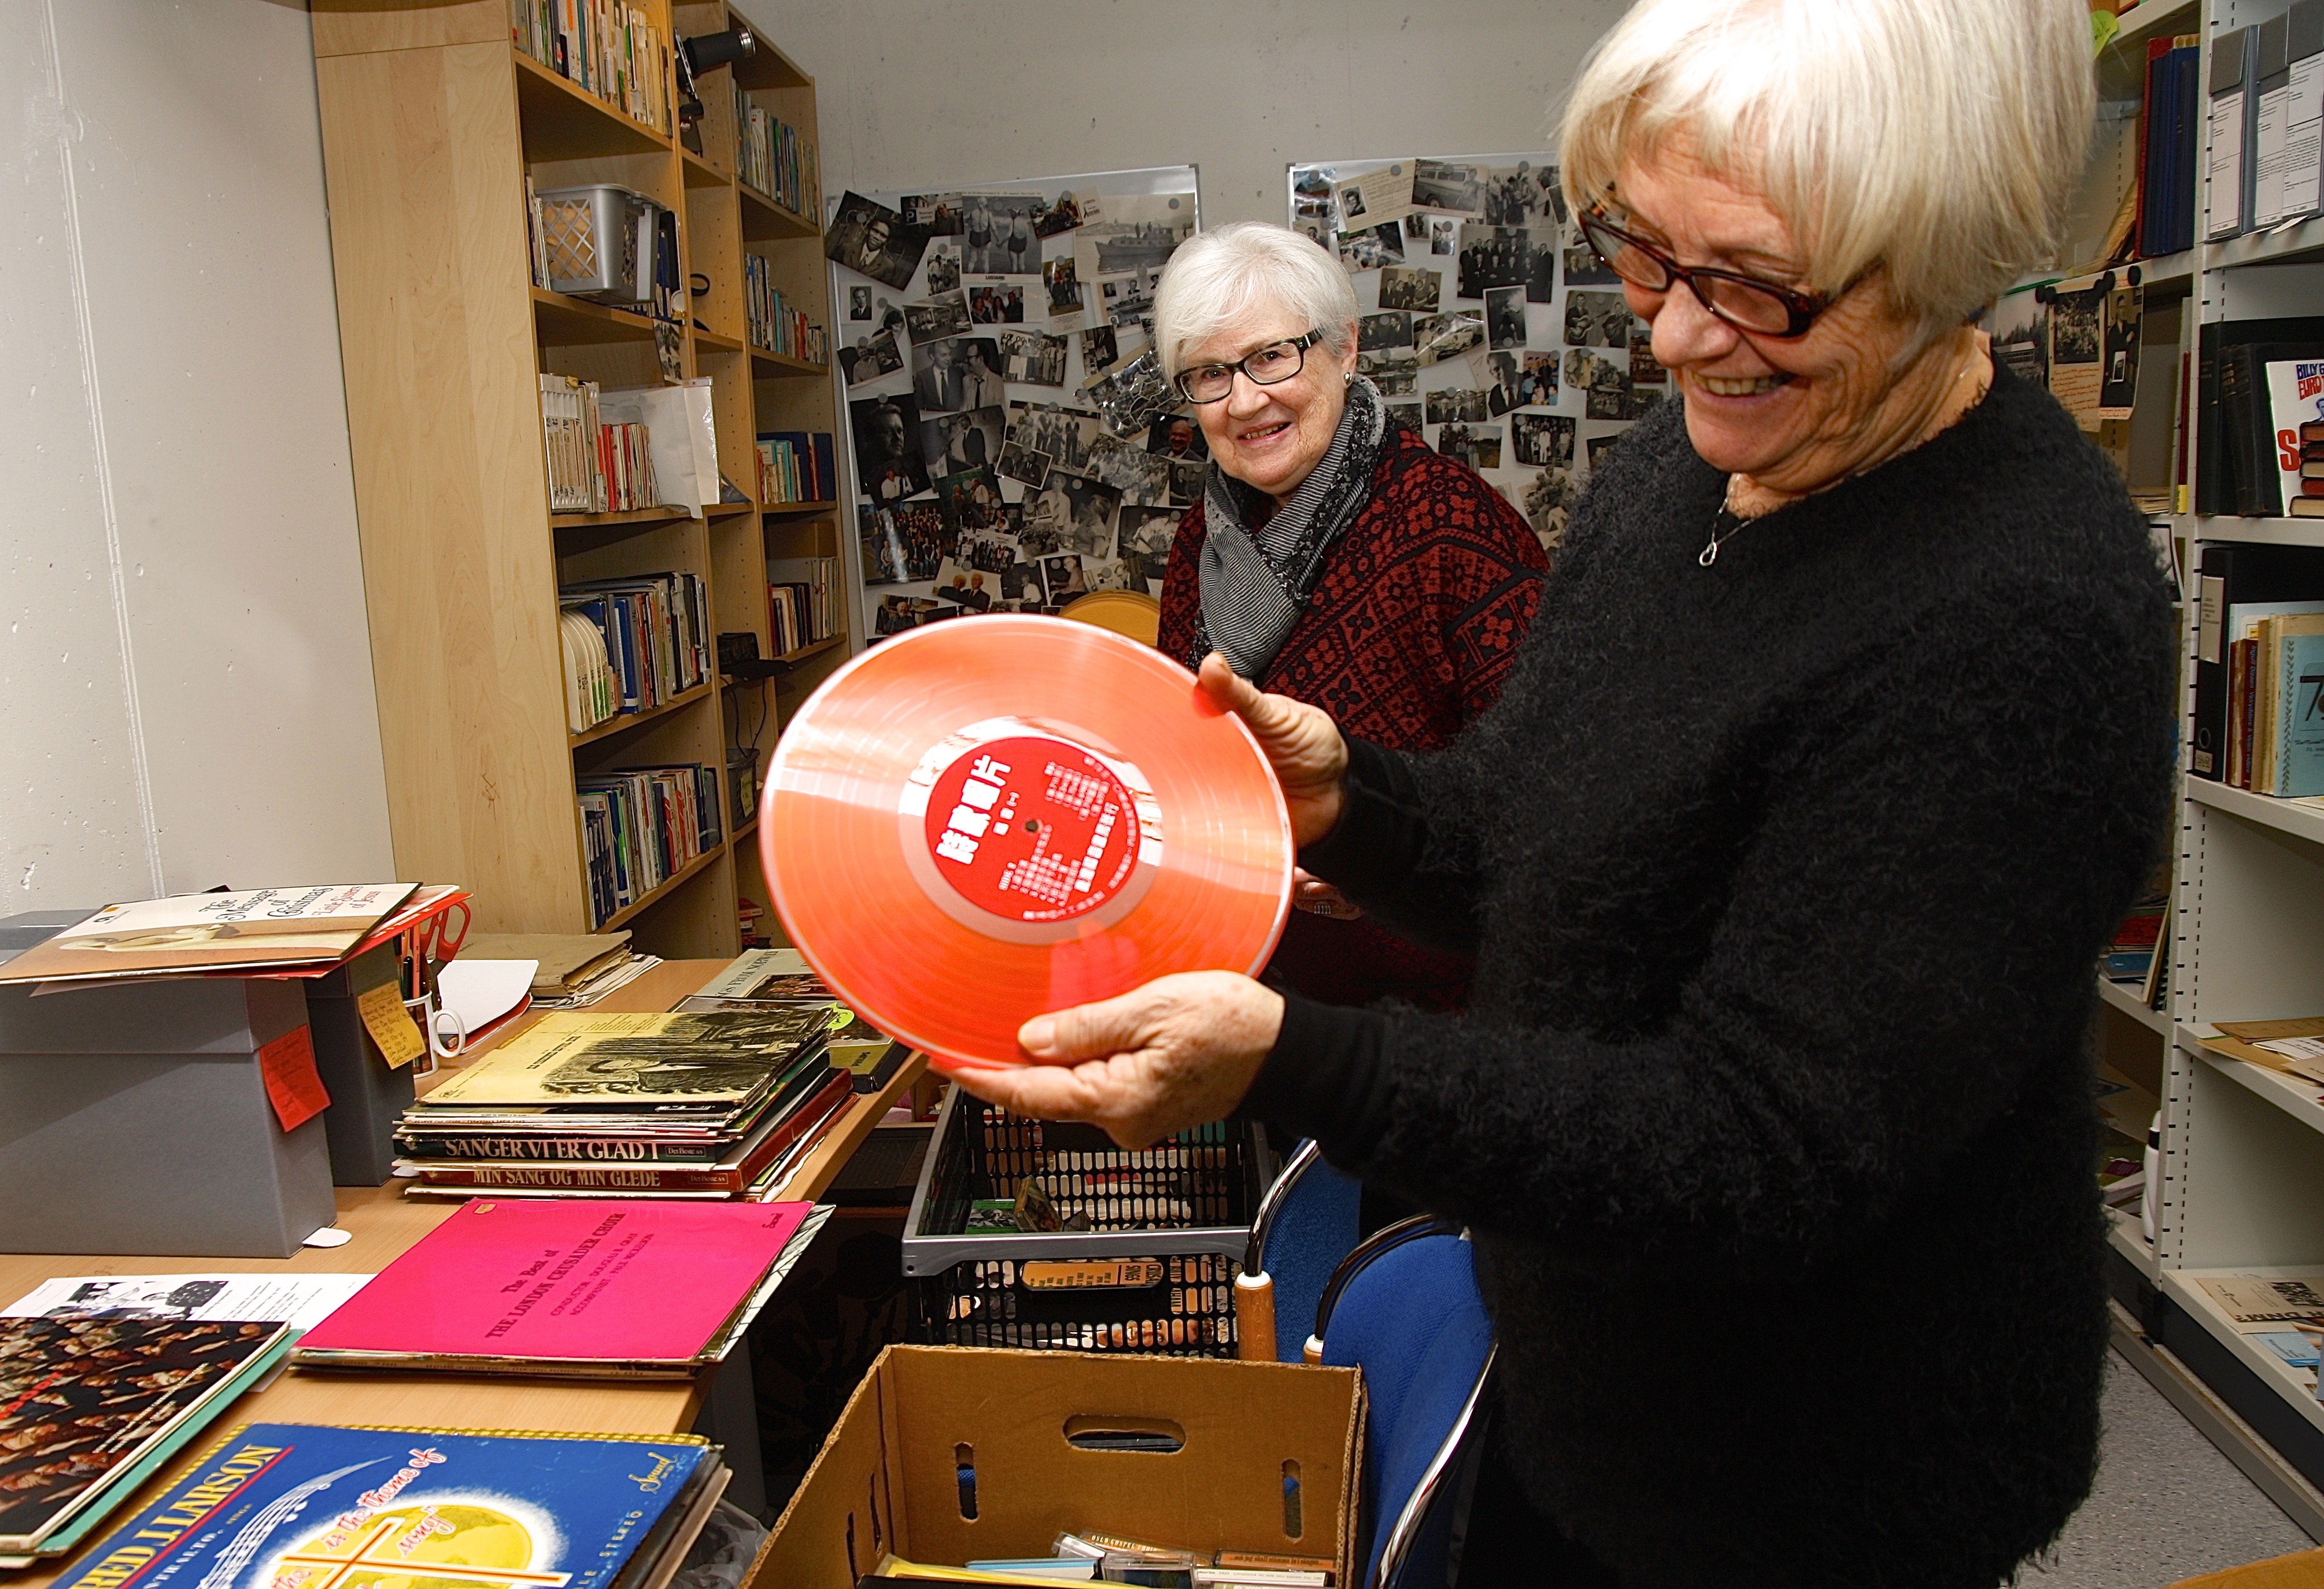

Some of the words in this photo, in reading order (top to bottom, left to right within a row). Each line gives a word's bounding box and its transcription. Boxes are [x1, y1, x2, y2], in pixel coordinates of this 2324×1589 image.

[2296, 364, 2317, 380] BILLY
[2297, 376, 2322, 400] EURO
[198, 899, 238, 912] The
[215, 890, 278, 921] Message
[267, 888, 334, 917] Christmas
[731, 970, 751, 987] FROM
[744, 951, 779, 974] NORWAY
[445, 1139, 522, 1158] SANGER
[527, 1140, 551, 1158] VI
[556, 1140, 579, 1158] ER
[588, 1141, 645, 1160] GLAD
[474, 1170, 501, 1184] MIN
[506, 1171, 545, 1185] SANG
[550, 1172, 571, 1185] OG
[578, 1172, 607, 1186] MIN
[610, 1172, 660, 1187] GLEDE
[485, 1318, 518, 1339] THE
[514, 1283, 555, 1316] LONDON
[549, 1238, 601, 1281] CRUSADER
[593, 1213, 626, 1236] CHOIR
[501, 1278, 529, 1293] The
[545, 1249, 559, 1258] of
[1126, 1265, 1142, 1282] SINGS
[1146, 1264, 1162, 1284] CRUSA
[150, 1443, 283, 1528] LARSON
[320, 1532, 347, 1551] is
[335, 1509, 374, 1533] the
[356, 1466, 422, 1509] theme
[408, 1447, 448, 1469] of
[599, 1510, 643, 1557] STEREO
[1091, 1535, 1109, 1543] OSLO
[1110, 1538, 1136, 1550] GOSPEL
